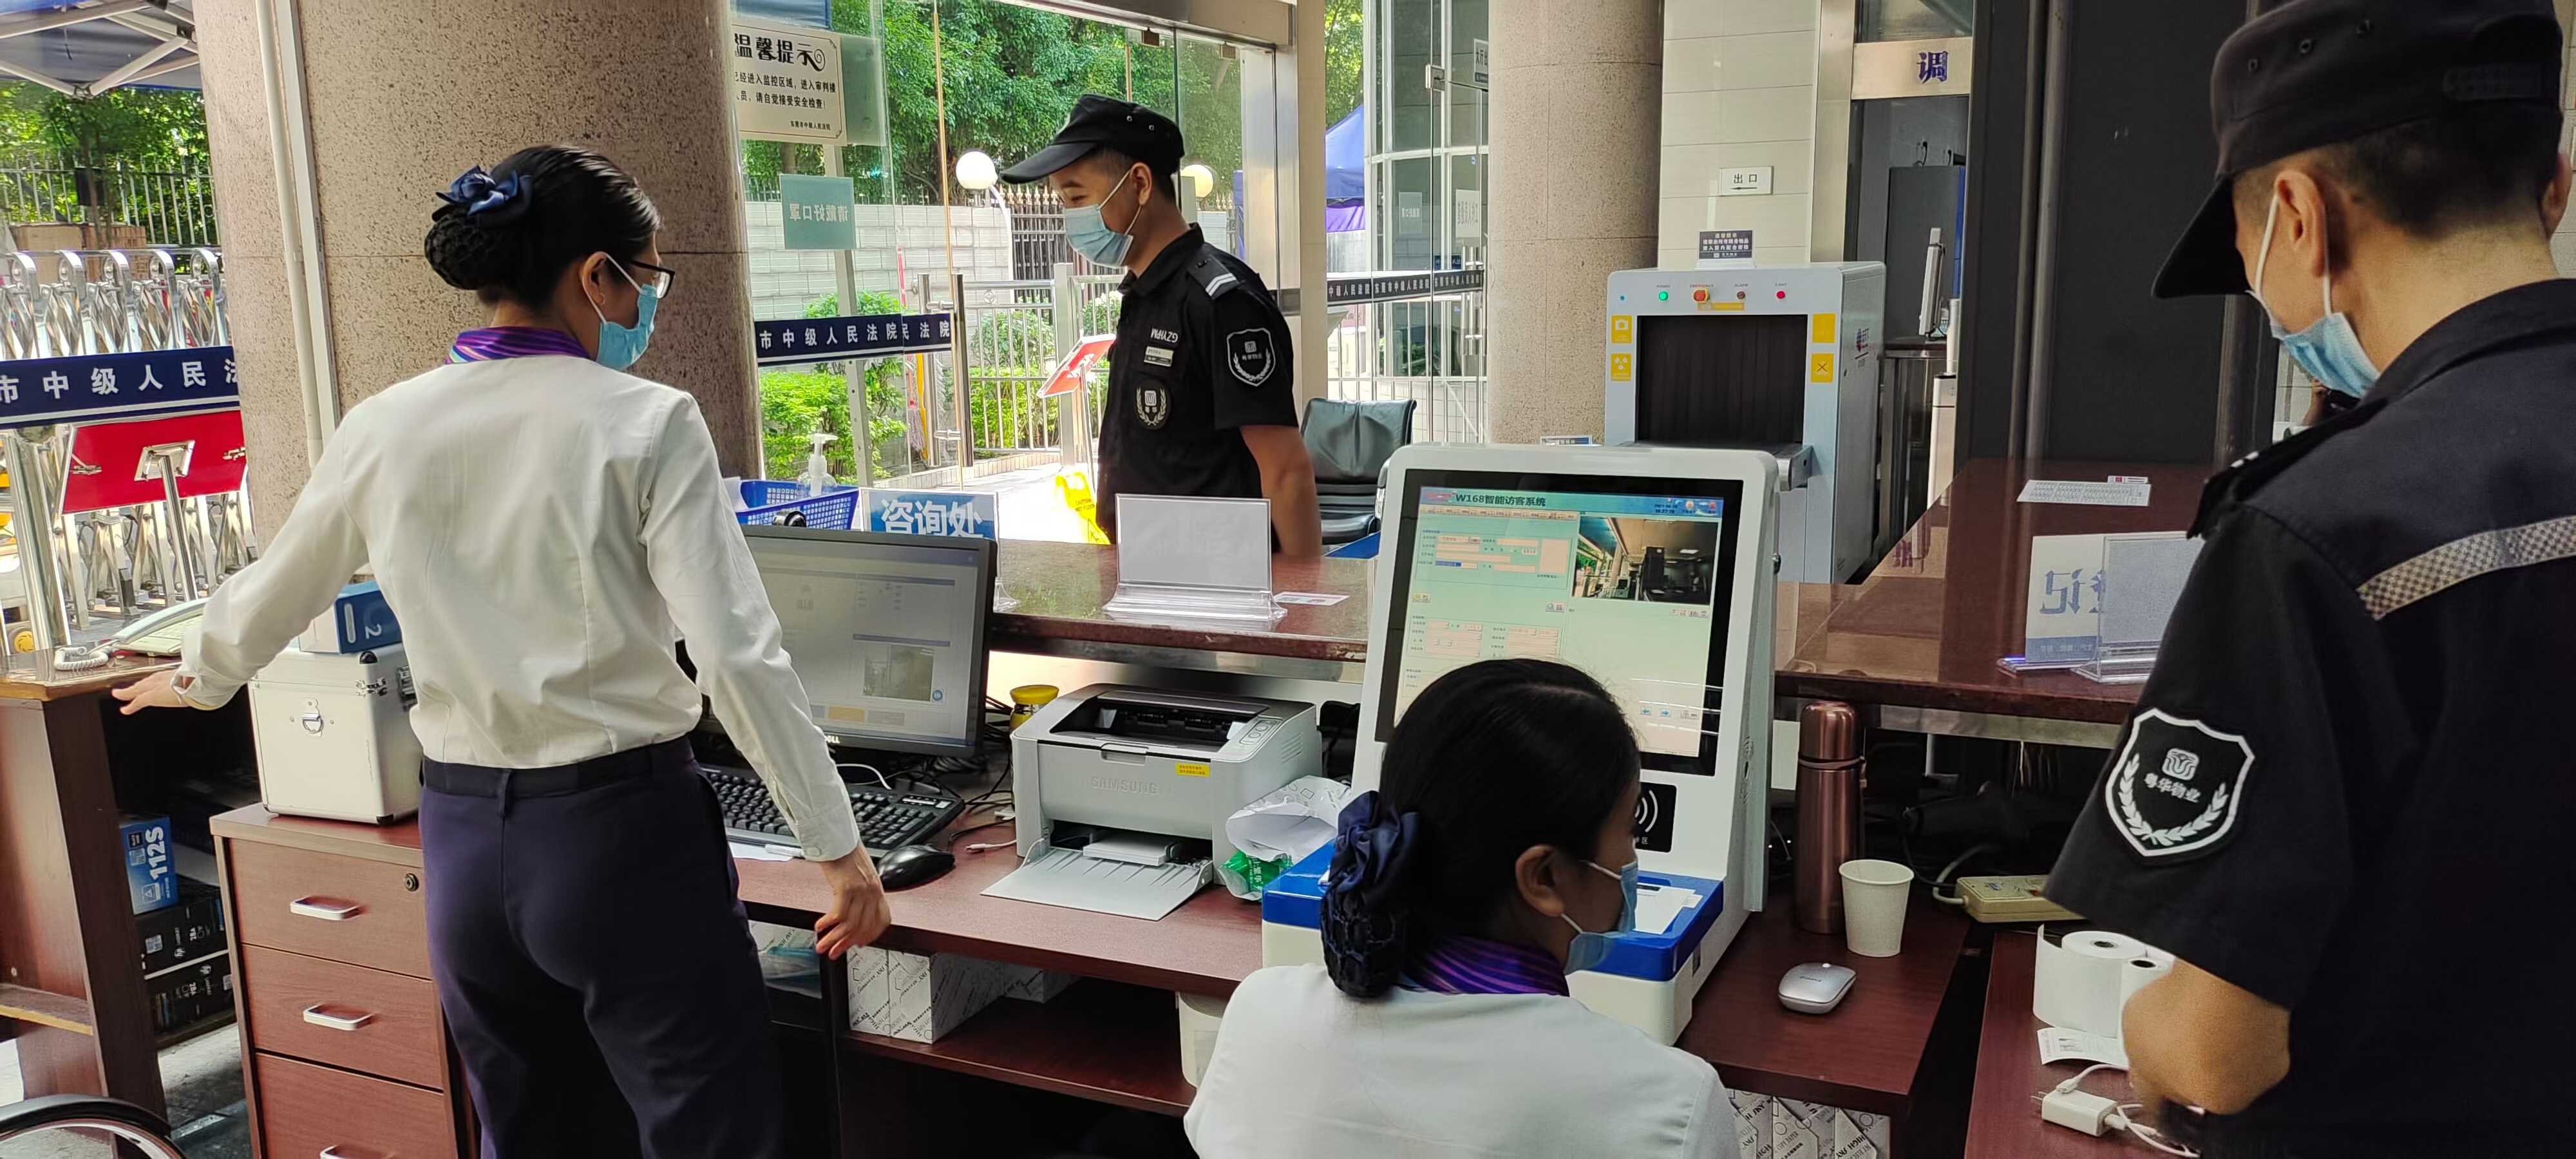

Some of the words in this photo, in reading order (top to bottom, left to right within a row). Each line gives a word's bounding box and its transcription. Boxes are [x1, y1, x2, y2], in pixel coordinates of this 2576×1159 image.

[735, 33, 826, 71] 温馨提示
[1917, 51, 1948, 83] 调
[736, 90, 826, 109] 员，请自觉接受安全检查！
[1734, 173, 1757, 184] 出口
[759, 323, 898, 350] 市中级人民法院
[1455, 494, 1546, 507] W168智能访客系统
[880, 499, 983, 538] 咨询处
[1092, 776, 1159, 796] SAMSUNG
[2144, 773, 2202, 803] 粤华物业
[146, 826, 168, 880] 112S
[174, 948, 185, 958] hp
[1848, 1134, 1866, 1149] HIGH
